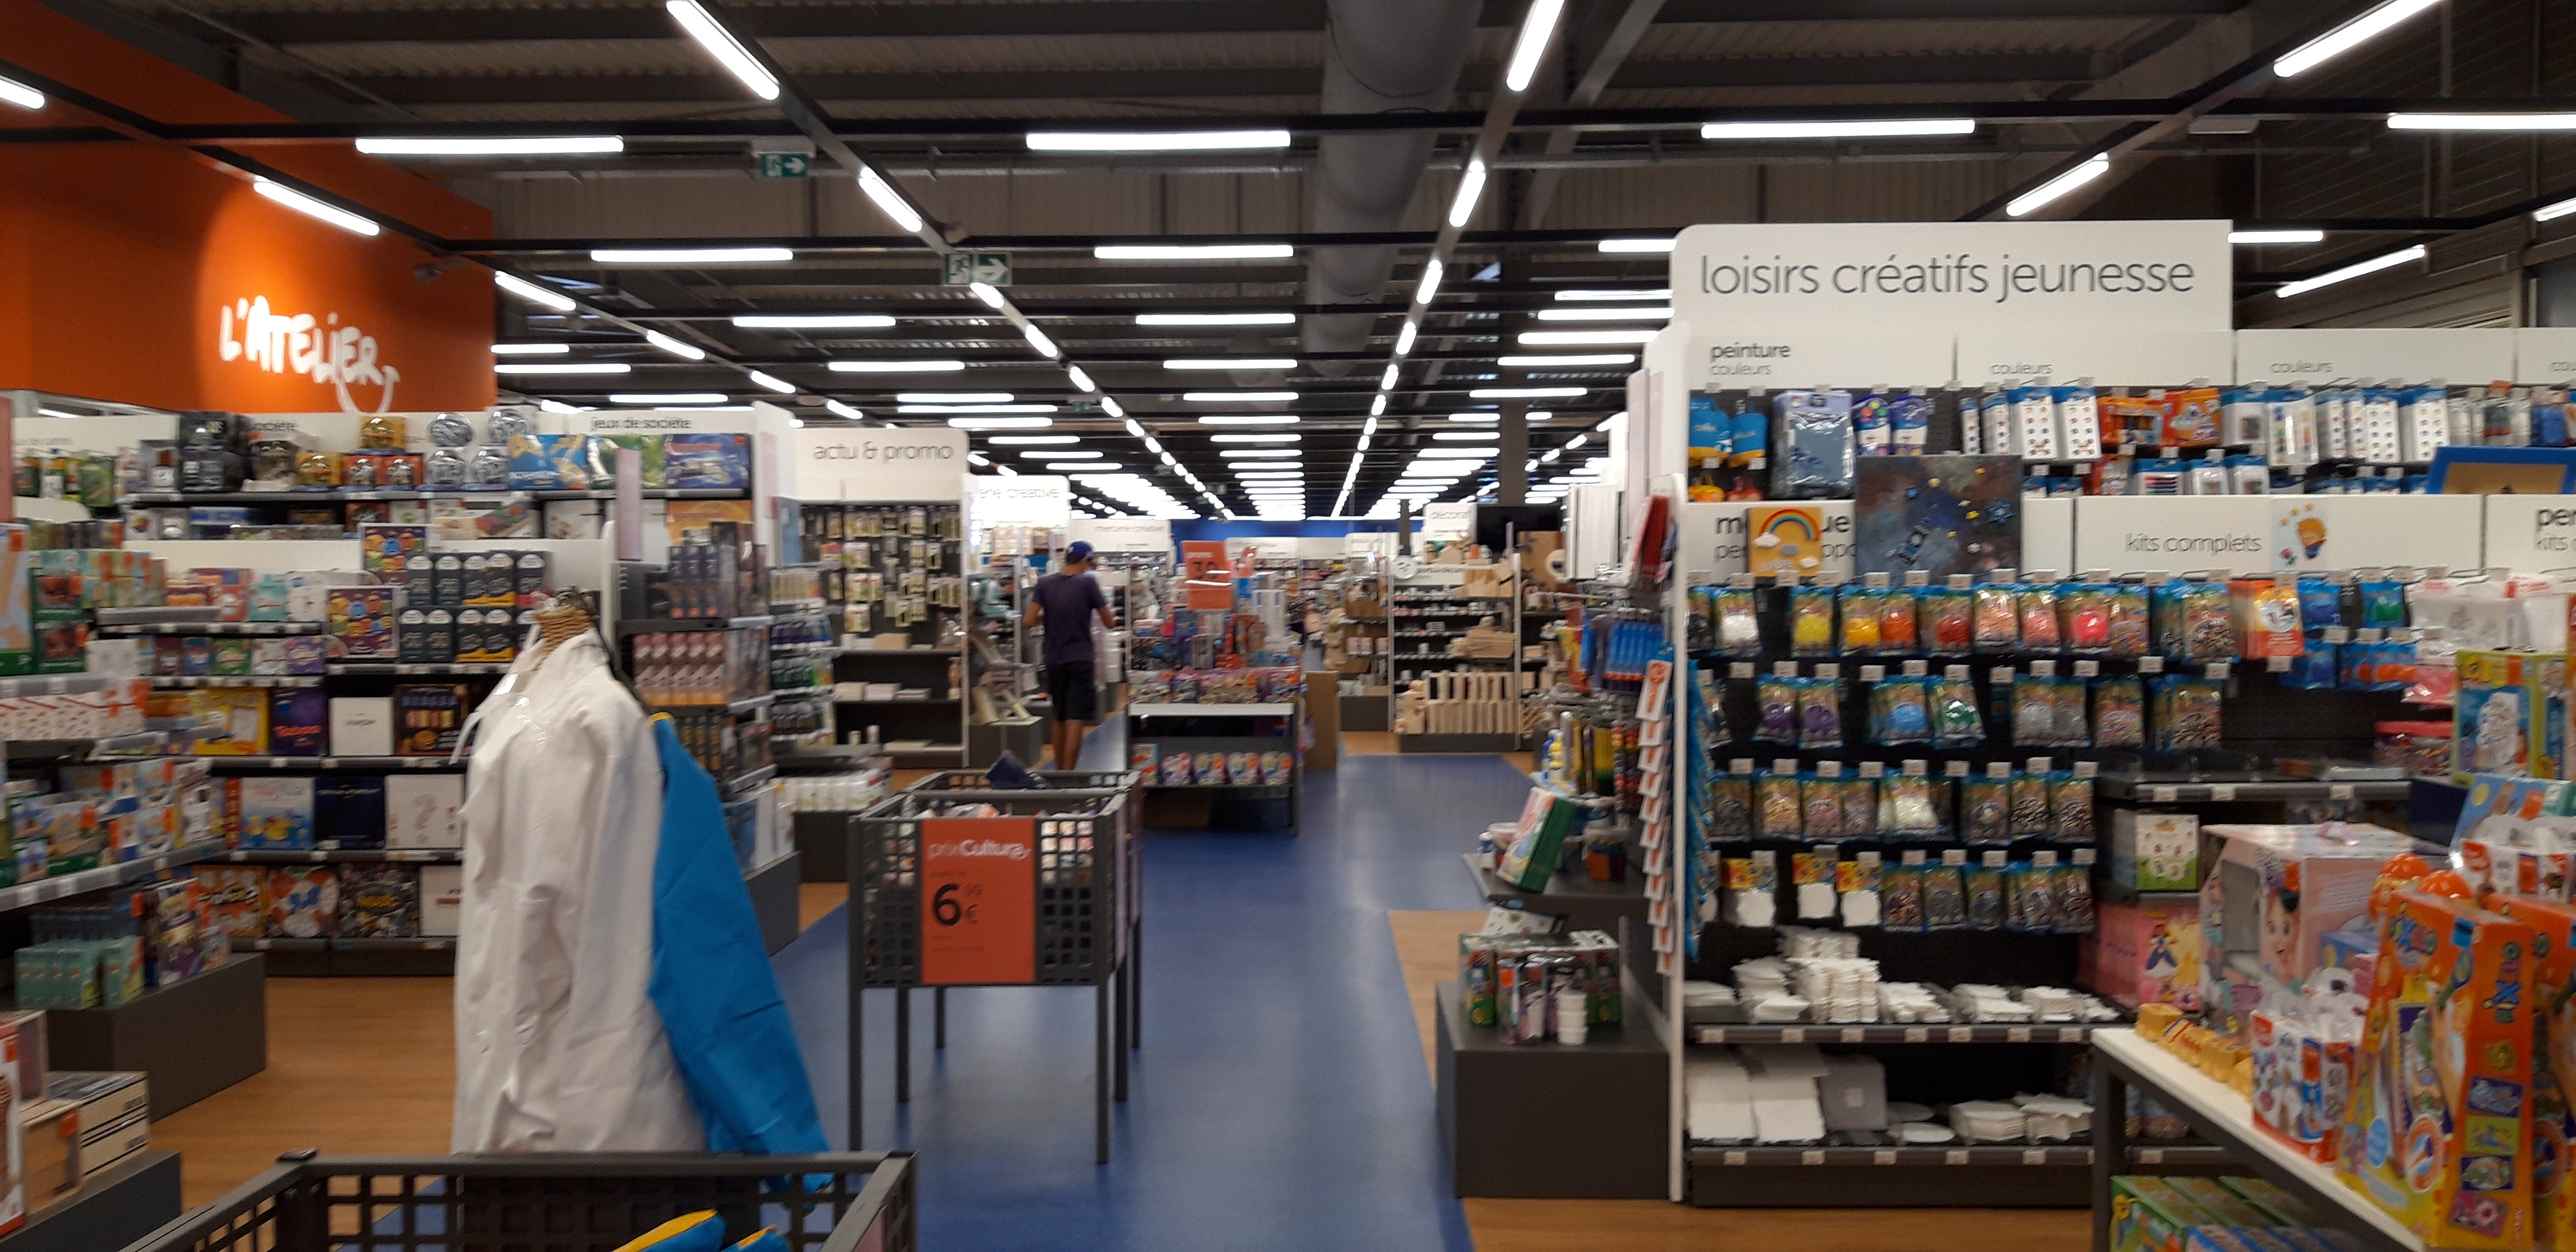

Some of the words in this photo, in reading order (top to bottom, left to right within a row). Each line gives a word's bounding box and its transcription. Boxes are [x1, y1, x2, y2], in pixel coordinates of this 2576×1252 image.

[1701, 254, 1820, 294] loisirs
[1831, 254, 1990, 293] créatifs
[1995, 253, 2195, 303] jeunesse
[1710, 342, 1791, 362] peinture
[1990, 362, 2053, 374] couleurs
[2269, 359, 2333, 373] couleurs
[813, 443, 859, 459] actu
[883, 445, 955, 464] promo
[2125, 532, 2160, 552] kits
[2162, 532, 2262, 557] complets
[932, 883, 962, 926] 6
